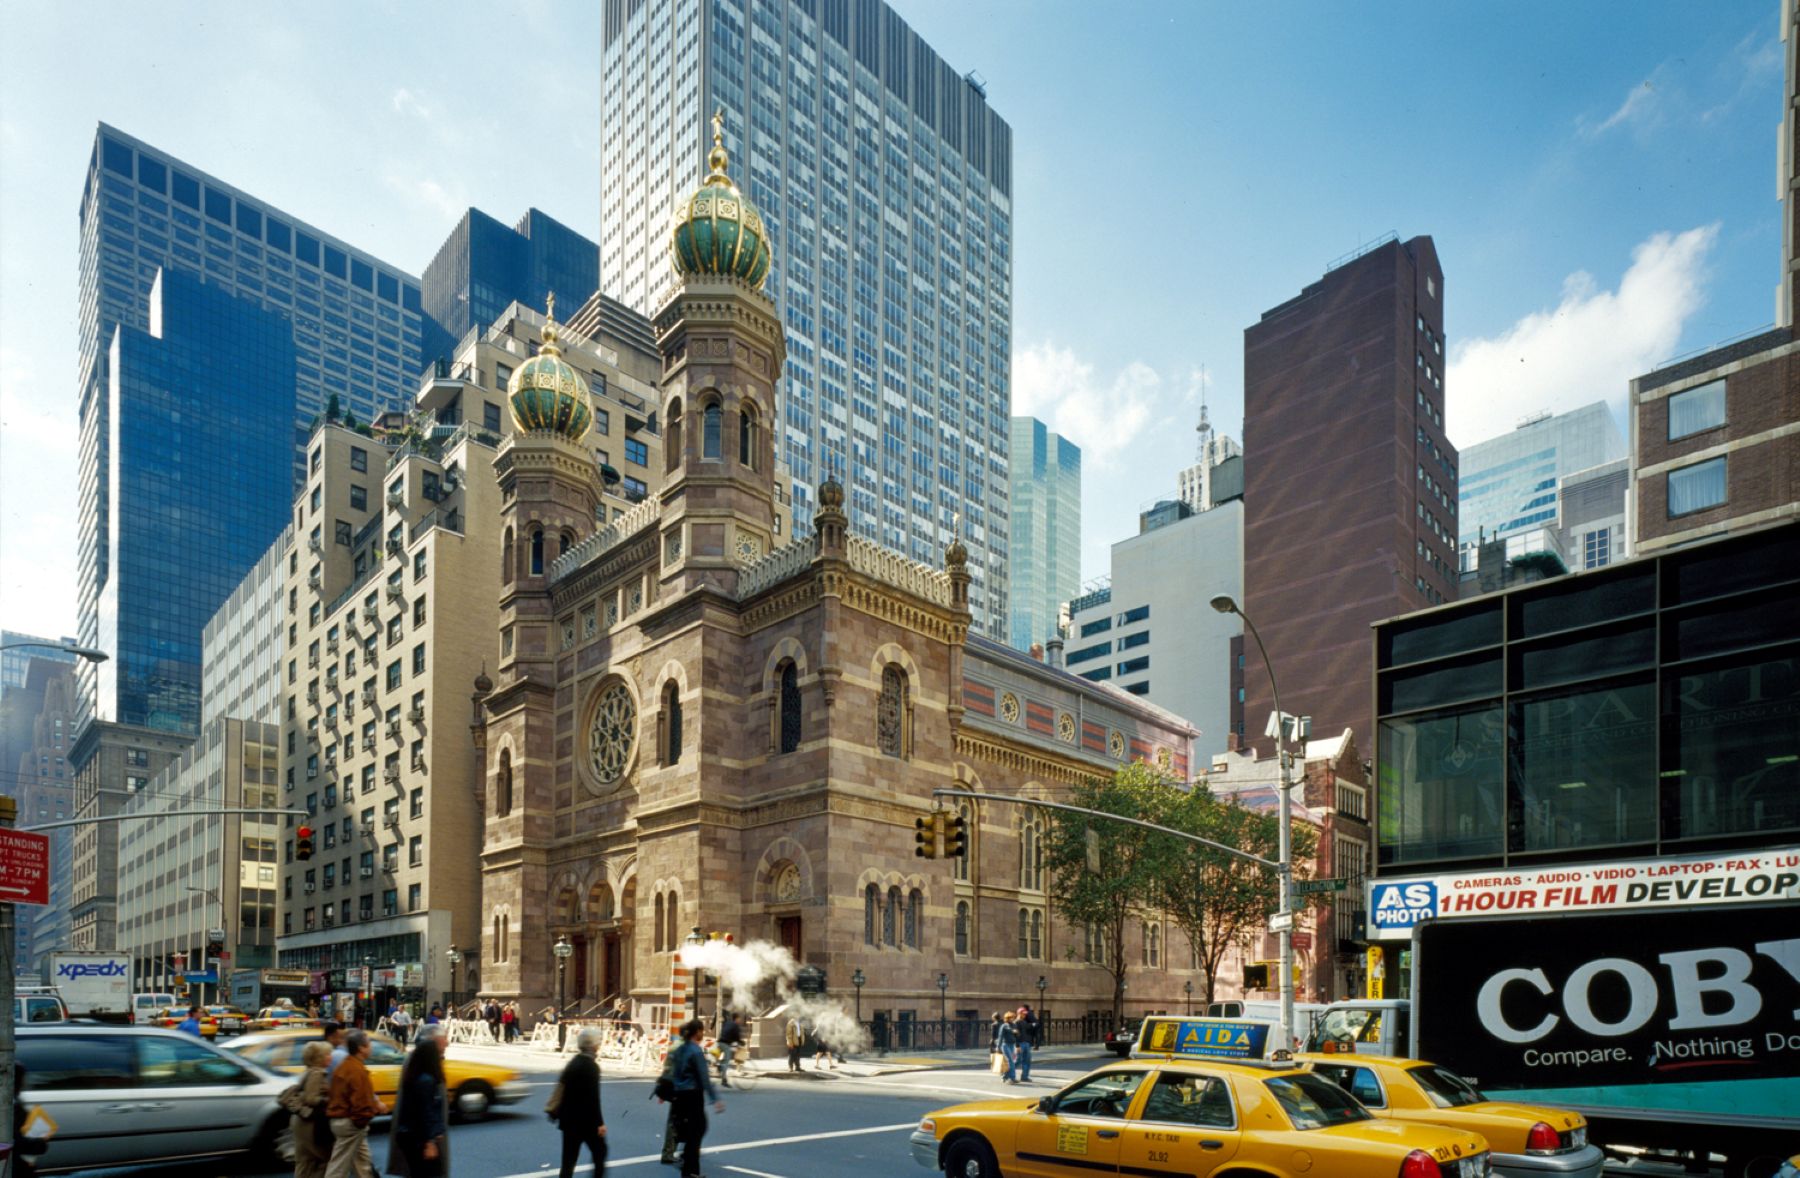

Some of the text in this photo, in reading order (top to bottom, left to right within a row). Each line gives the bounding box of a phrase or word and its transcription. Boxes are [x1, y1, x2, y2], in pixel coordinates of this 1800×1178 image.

[0, 836, 44, 851] TANDING
[1453, 855, 1800, 890] CAMERAS AUDIO VIDIO LAPTOP FAX LU
[1543, 884, 1618, 908] FILM
[1625, 872, 1800, 903] DEVELOP
[1375, 907, 1434, 924] PHOTO
[1184, 1028, 1251, 1045] AIDA
[1523, 1047, 1633, 1068] Compare.
[1654, 1036, 1755, 1058] Nothing
[1165, 1133, 1180, 1142] TAXI
